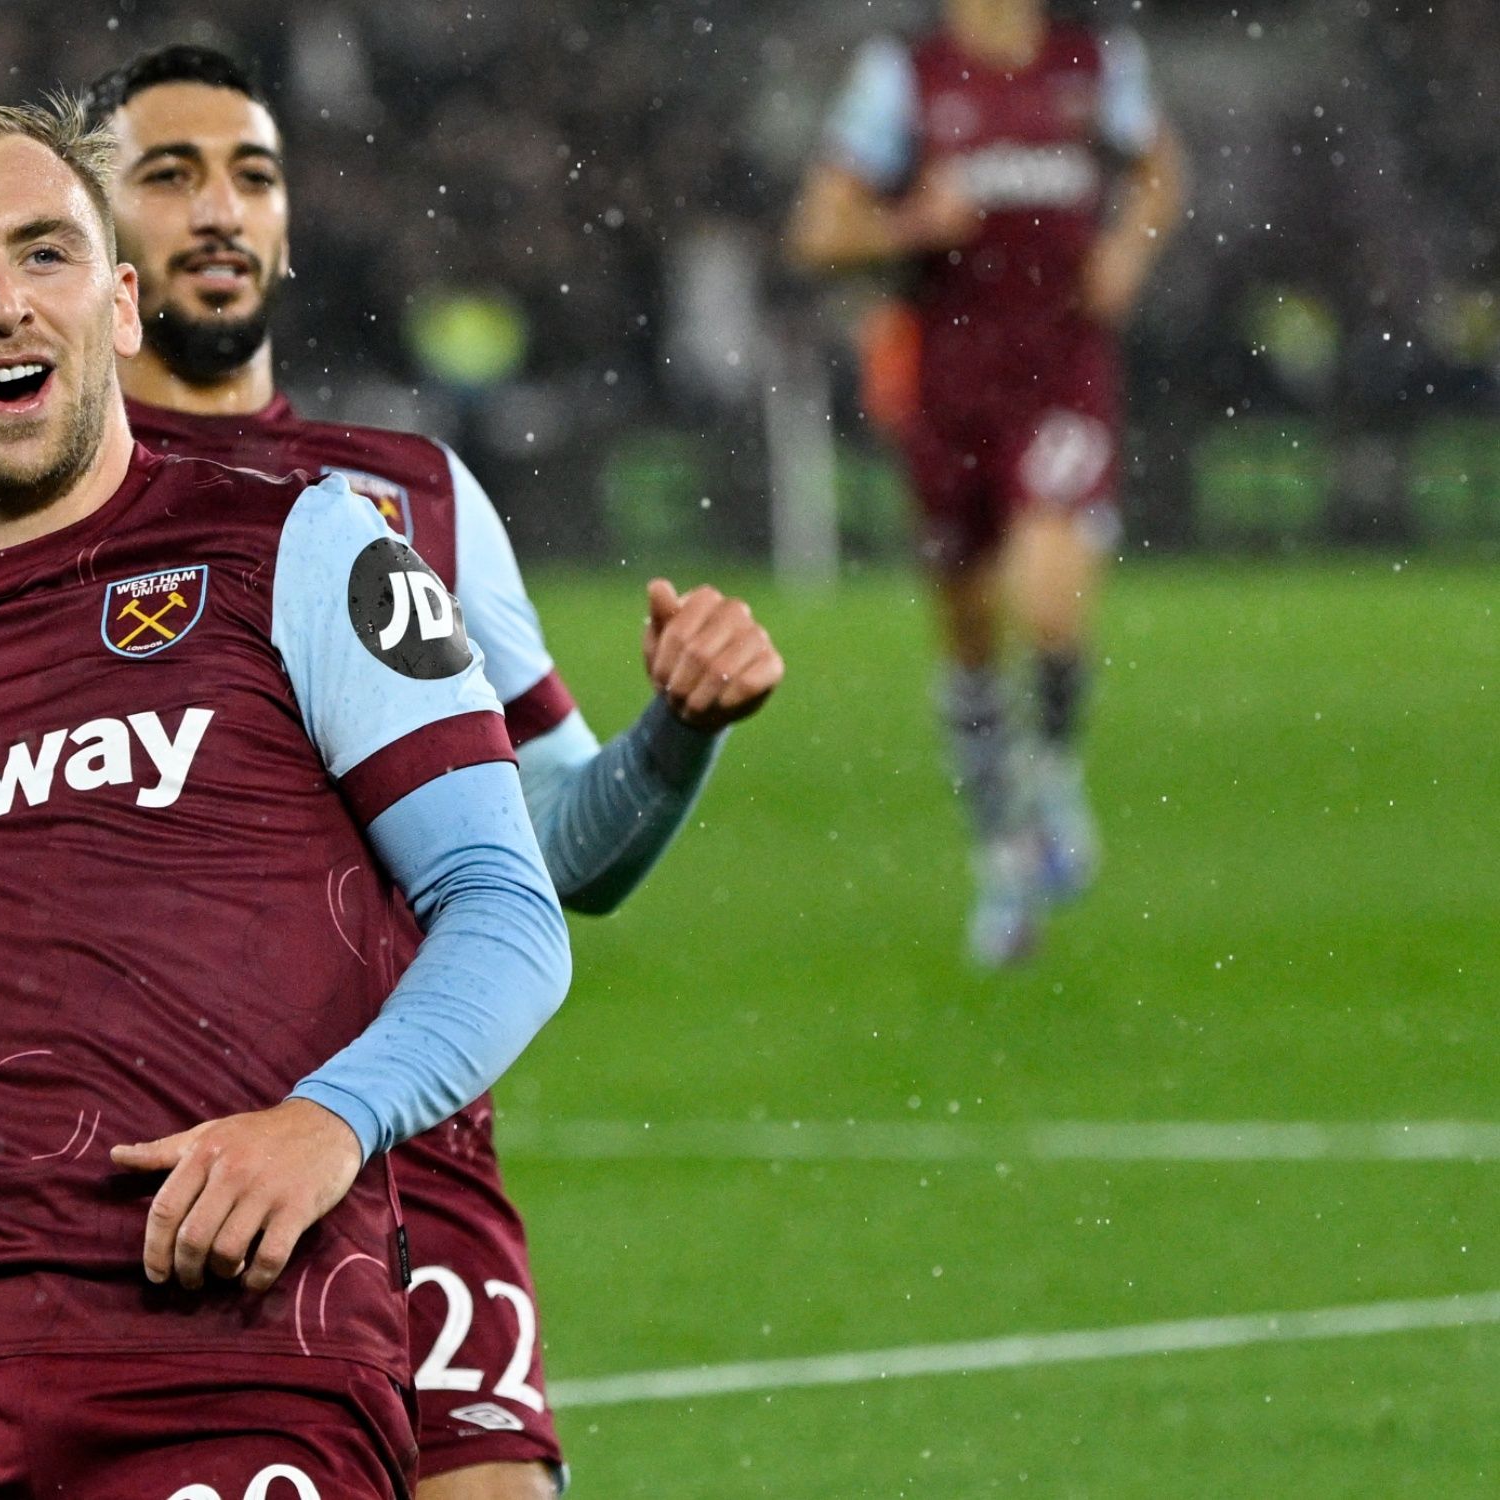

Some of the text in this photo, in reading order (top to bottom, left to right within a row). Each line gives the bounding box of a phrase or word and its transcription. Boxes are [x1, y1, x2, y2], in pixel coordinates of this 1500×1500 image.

[117, 570, 196, 594] WEST HAM
[132, 583, 178, 598] UNITED
[379, 570, 454, 651] JD
[126, 640, 163, 651] LONDON
[405, 1264, 545, 1414] 22
